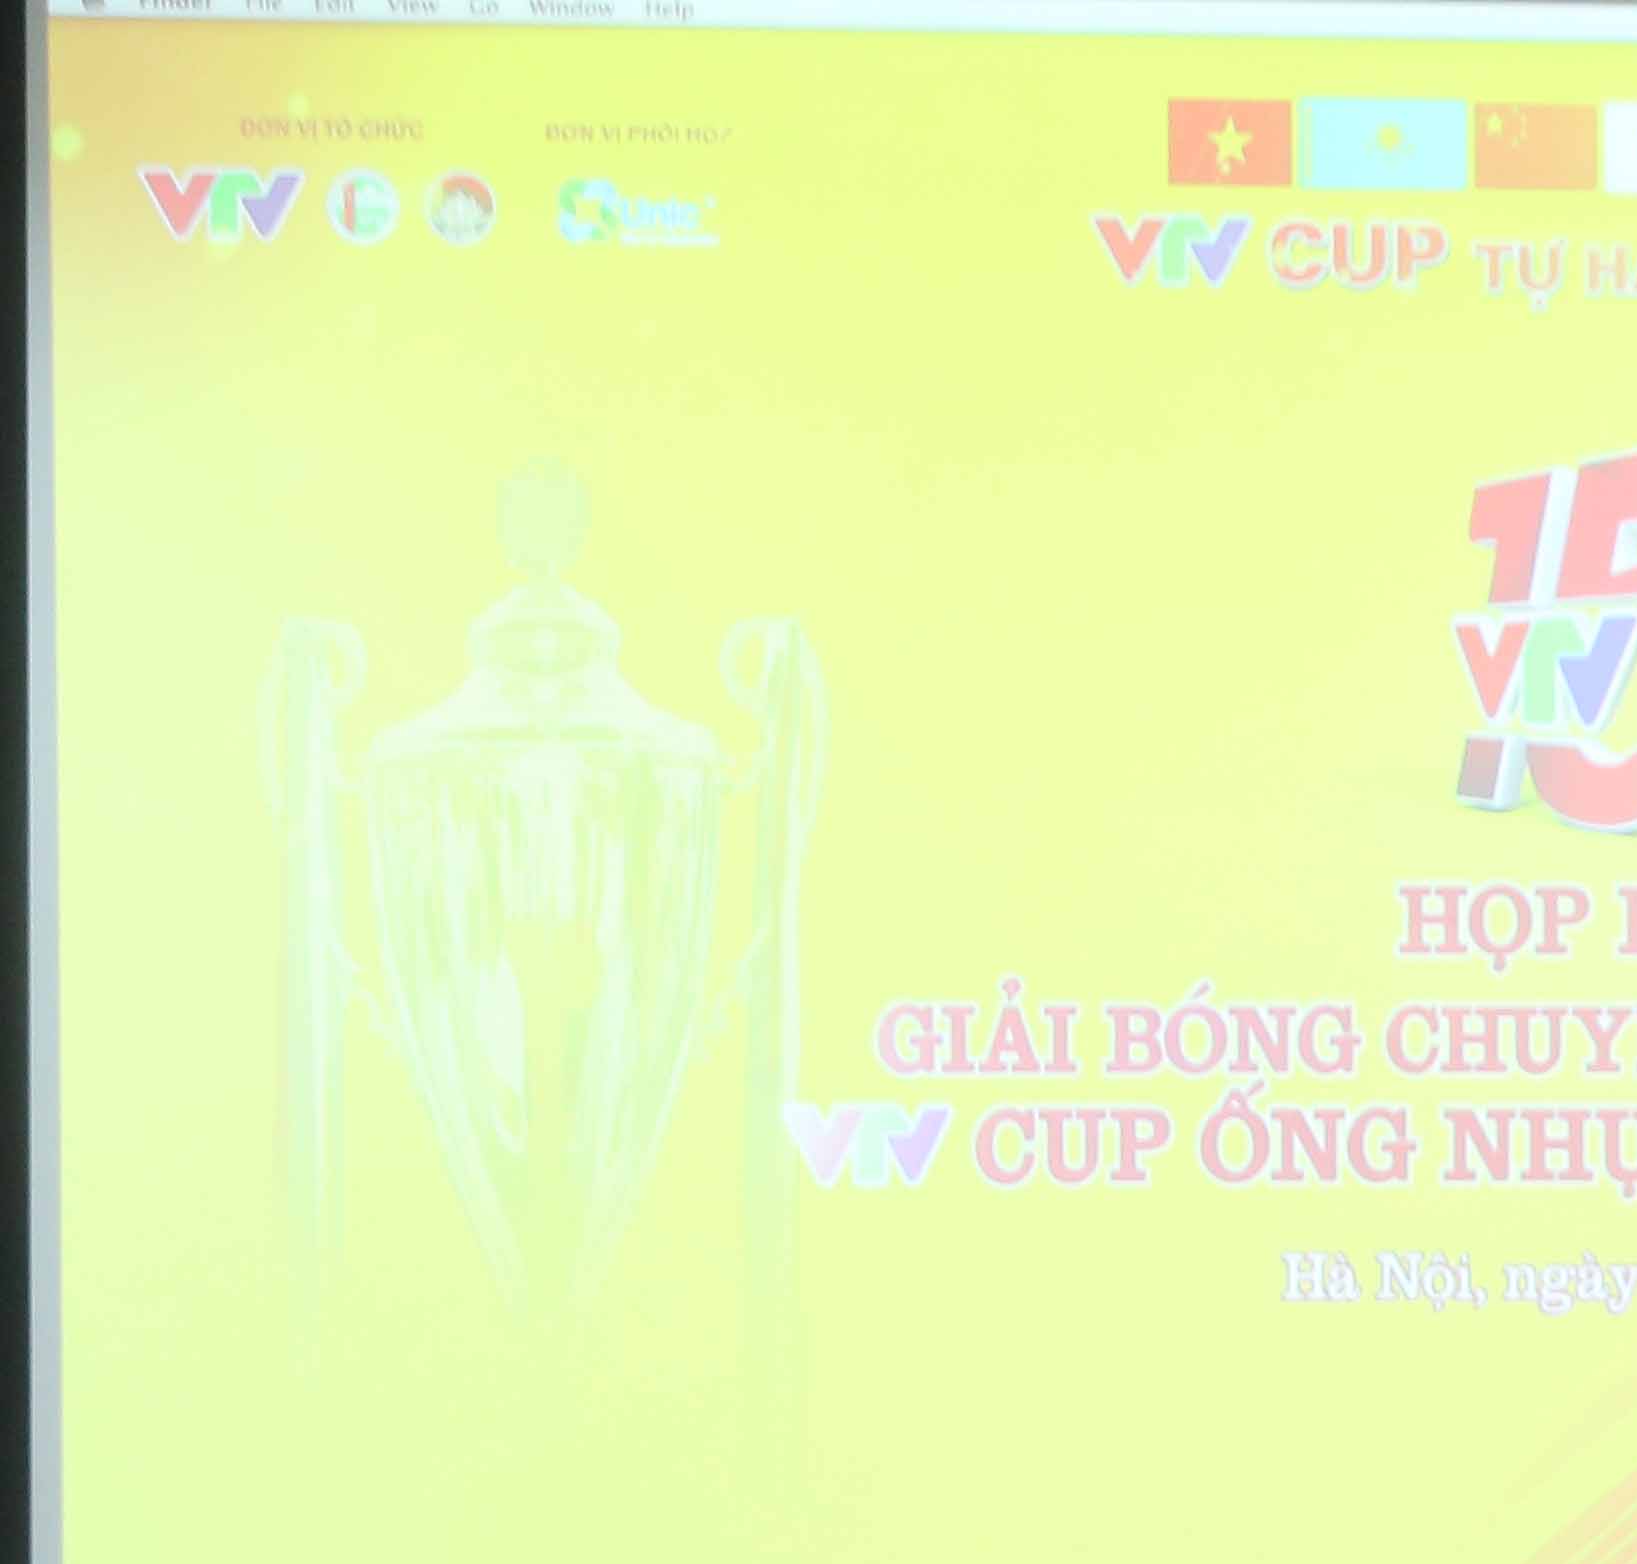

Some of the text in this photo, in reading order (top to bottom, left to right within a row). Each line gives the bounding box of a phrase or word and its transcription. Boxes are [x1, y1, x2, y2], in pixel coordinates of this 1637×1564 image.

[529, 0, 614, 17] Window
[140, 170, 303, 242] VTV
[1093, 214, 1249, 288] VTV
[1269, 219, 1448, 290] CUP
[1400, 884, 1590, 972] HỌP
[877, 978, 1078, 1075] GIẢI
[1104, 984, 1362, 1075] BÓNG
[784, 1104, 950, 1186] VTV
[974, 1107, 1172, 1183] CUP
[1199, 1081, 1418, 1183] ỐNG
[1281, 1251, 1361, 1302] Hà
[1375, 1251, 1488, 1313] Nội,
